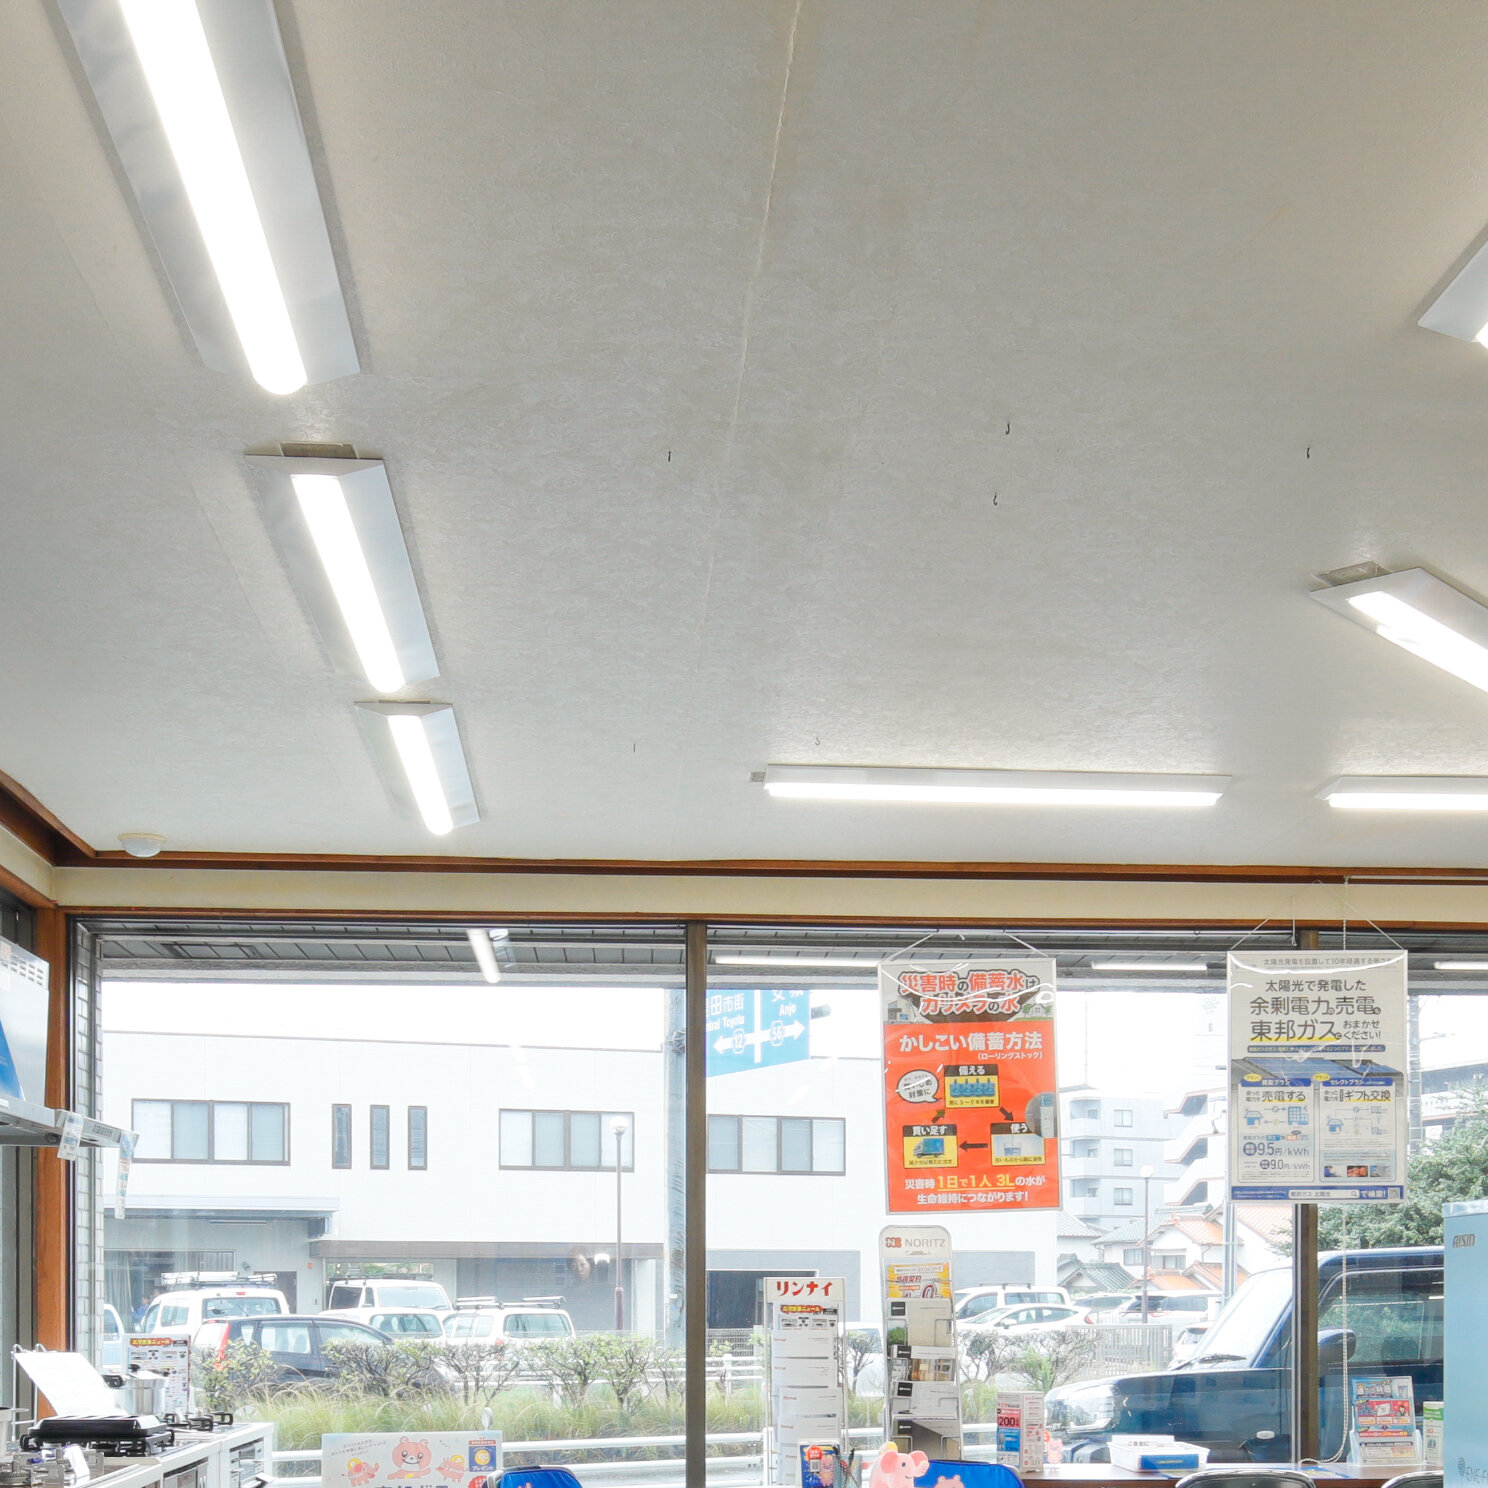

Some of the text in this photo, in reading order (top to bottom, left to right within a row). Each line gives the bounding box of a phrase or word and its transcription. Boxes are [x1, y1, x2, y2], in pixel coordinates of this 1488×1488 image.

[1265, 979, 1367, 993] 太陽光で発電した
[1343, 1020, 1380, 1029] おまかせ
[1343, 1031, 1382, 1040] ください!
[900, 1031, 1043, 1052] かしこい備蓄方法
[1262, 1090, 1306, 1102] 売電する
[1011, 1123, 1028, 1132] 使う
[905, 1238, 946, 1248] NORITZ
[777, 1281, 834, 1297] リンナイ
